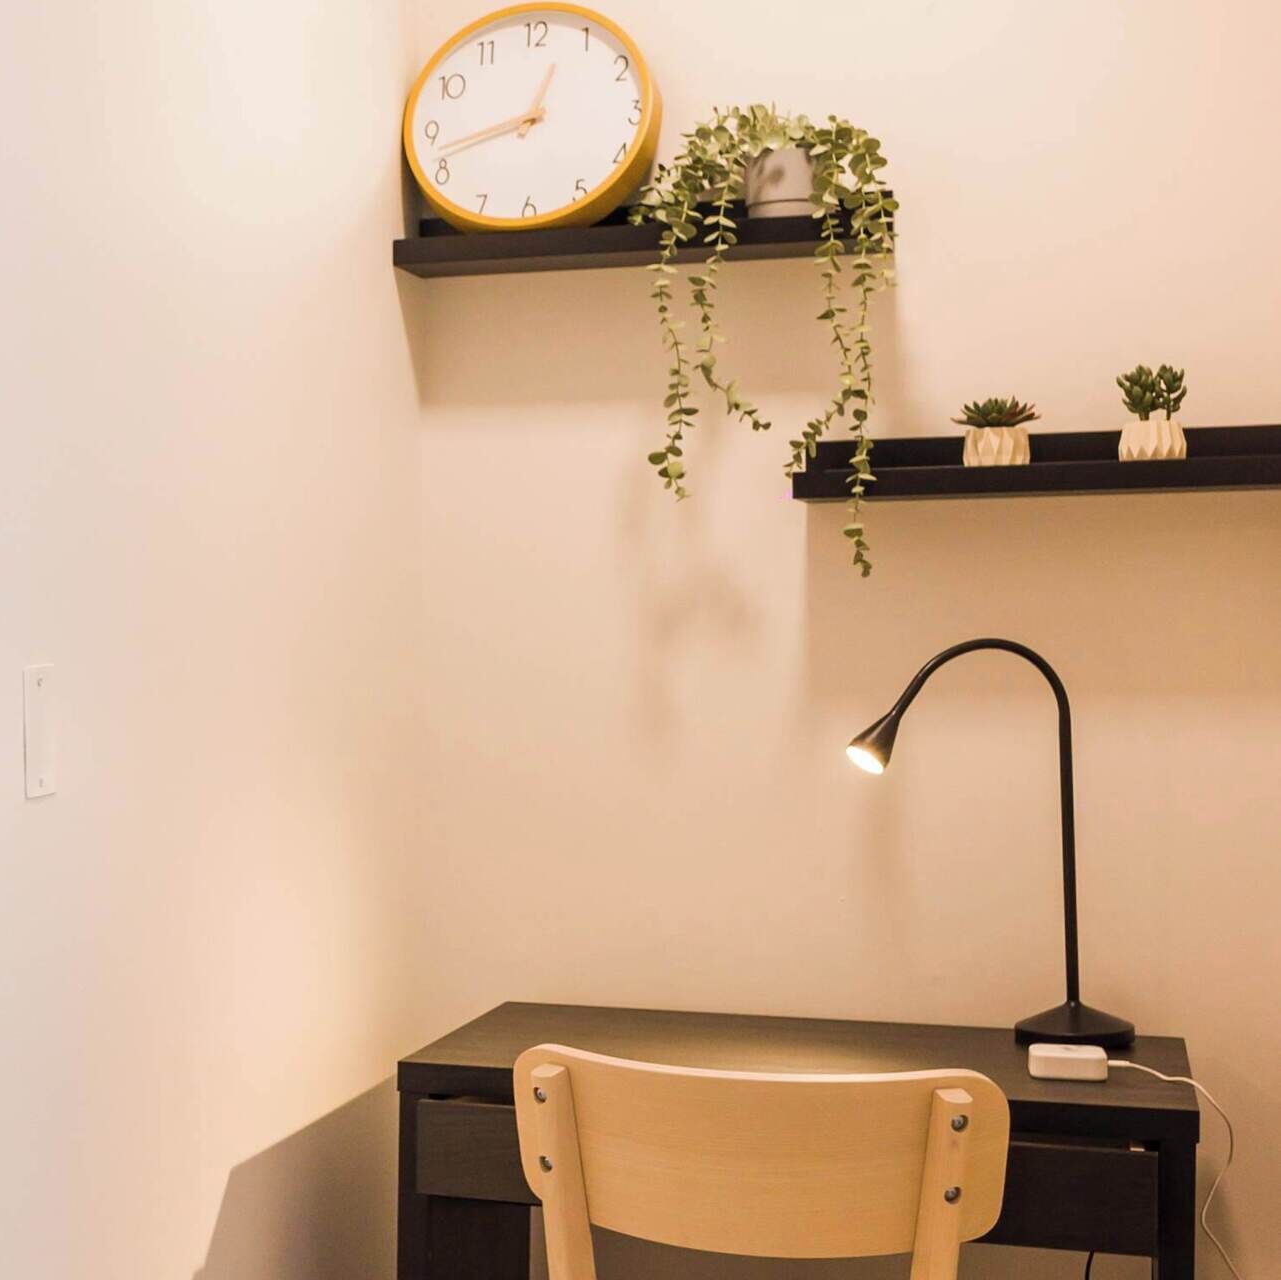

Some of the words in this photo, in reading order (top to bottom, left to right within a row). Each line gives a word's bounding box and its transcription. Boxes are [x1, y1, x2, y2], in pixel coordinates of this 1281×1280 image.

[523, 20, 549, 48] 12
[581, 27, 590, 51] 1
[477, 40, 495, 65] 11
[613, 55, 629, 82] 2
[439, 73, 466, 100] 10
[628, 99, 643, 125] 3
[424, 120, 439, 146] 9
[613, 143, 629, 165] 4
[435, 159, 450, 185] 8
[572, 179, 588, 202] 5
[475, 194, 488, 215] 7
[521, 195, 537, 218] 6
